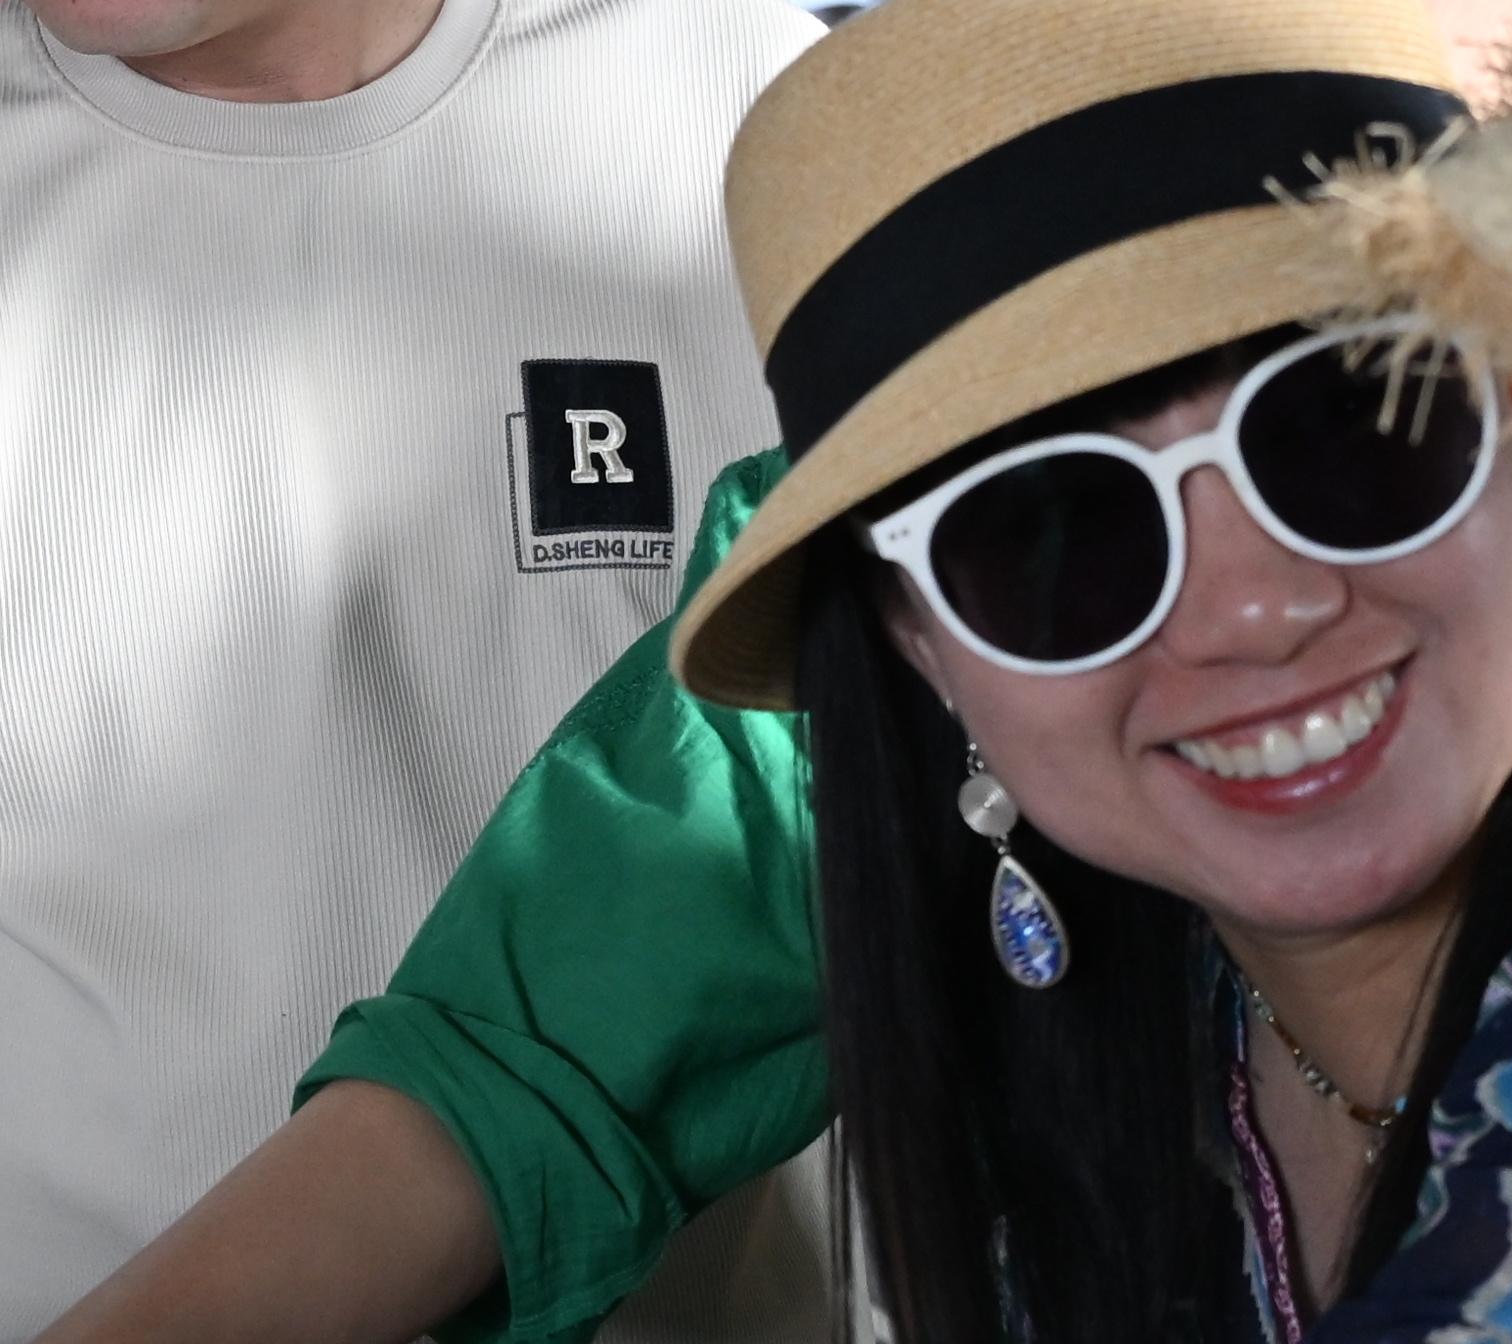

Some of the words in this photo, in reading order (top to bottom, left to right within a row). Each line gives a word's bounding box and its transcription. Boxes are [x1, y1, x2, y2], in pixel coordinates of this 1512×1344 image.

[564, 408, 635, 484] R
[532, 538, 625, 564] D.SHENG
[630, 538, 675, 561] LIFE
